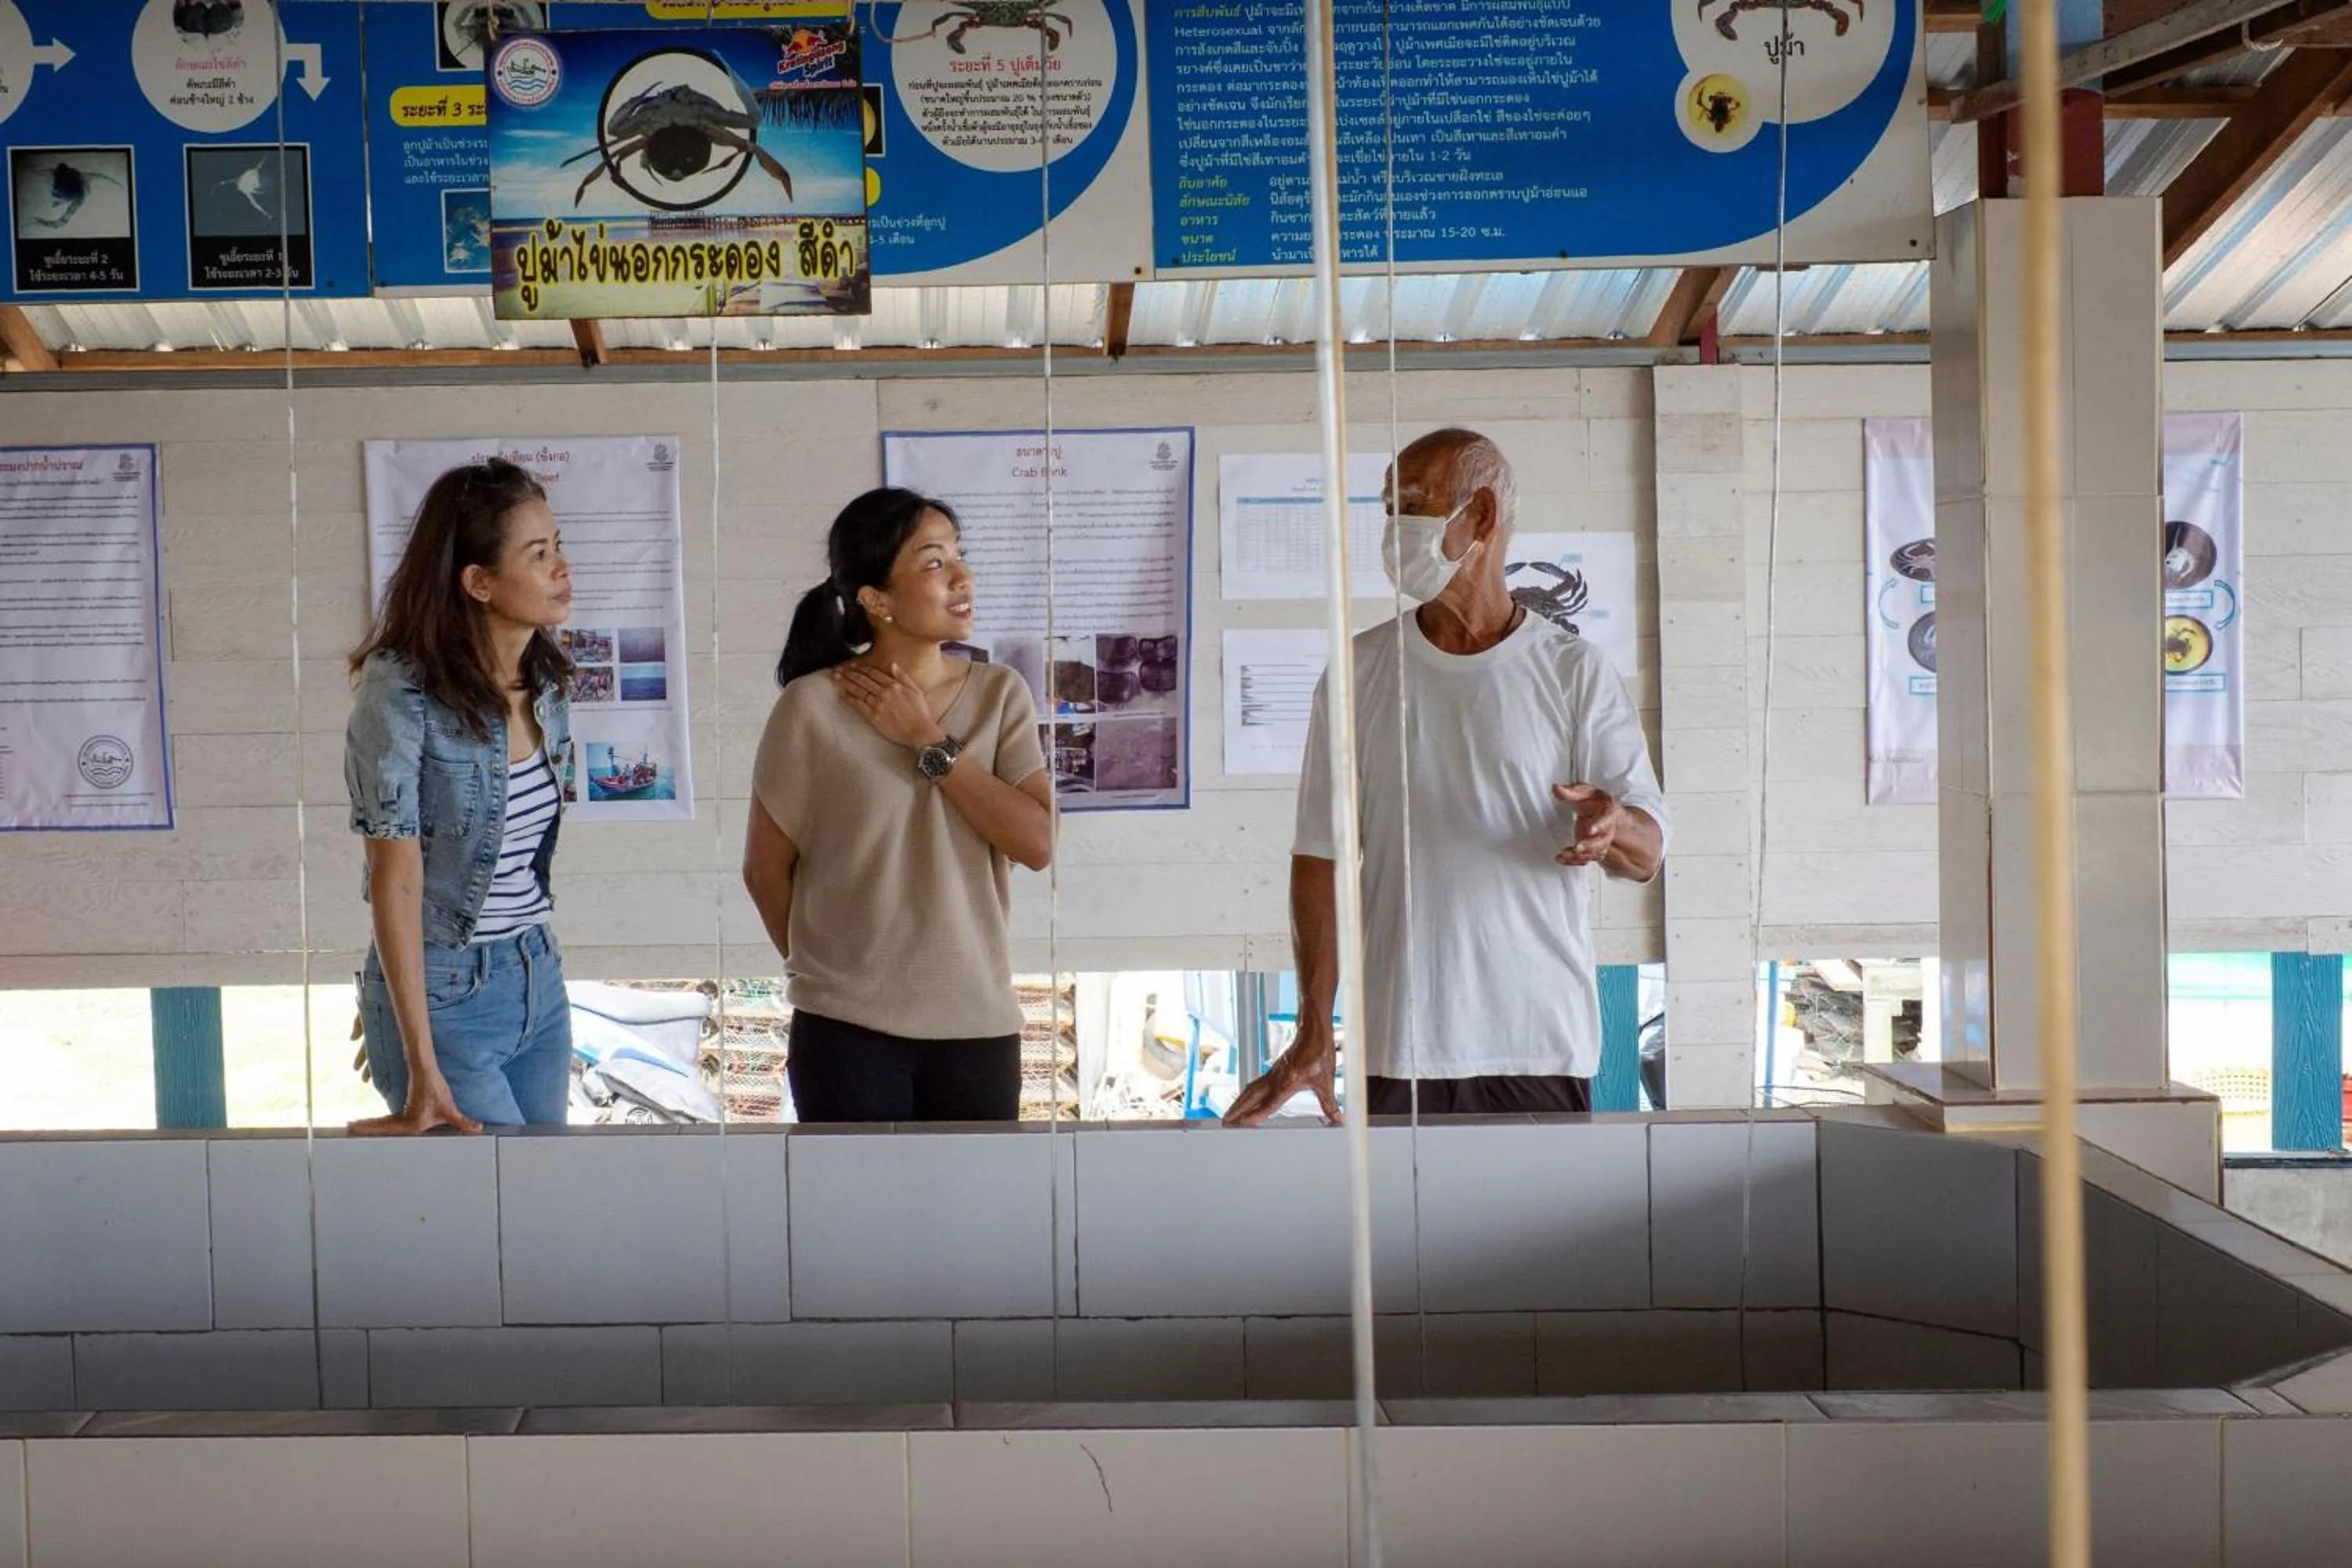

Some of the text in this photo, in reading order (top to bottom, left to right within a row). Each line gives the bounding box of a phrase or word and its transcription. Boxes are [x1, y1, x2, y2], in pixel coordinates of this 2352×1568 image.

[1764, 32, 1804, 64] ปูม้า
[452, 103, 462, 117] 3
[515, 220, 855, 311] ปูม้าไข่นอกกระดอง สีดำ
[1041, 466, 1067, 477] Bnk
